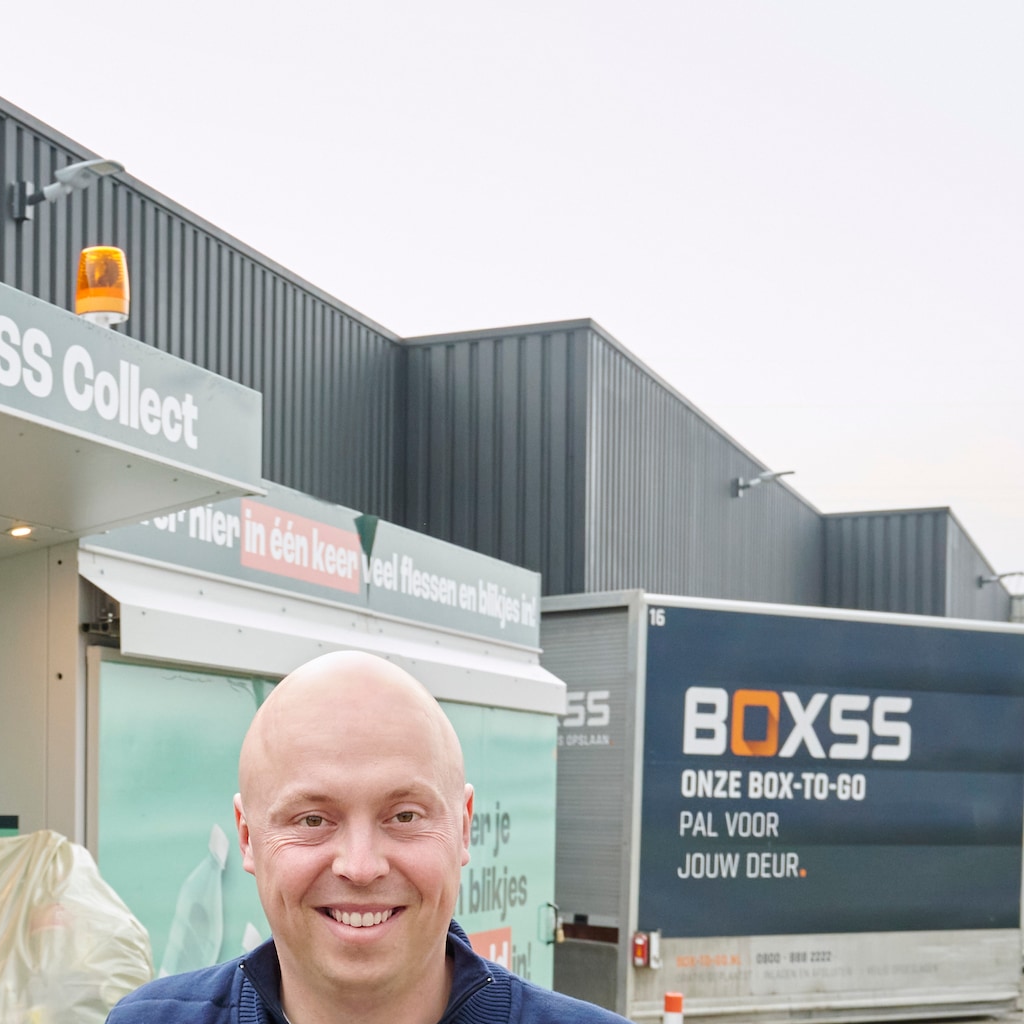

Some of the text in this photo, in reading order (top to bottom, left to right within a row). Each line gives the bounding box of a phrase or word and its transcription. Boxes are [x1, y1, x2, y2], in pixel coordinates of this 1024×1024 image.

[62, 344, 198, 450] Collect
[245, 508, 266, 557] in
[270, 515, 309, 568] één
[312, 527, 358, 579] keer
[361, 553, 398, 592] veel
[401, 554, 457, 607] flessen
[459, 582, 477, 613] en
[478, 578, 521, 629] blikjes
[649, 608, 666, 627] 16
[683, 686, 912, 761] BOXSS
[681, 769, 866, 801] ONZE BOX-TO-GO
[493, 801, 511, 858] je
[679, 811, 779, 838] PAL VOOR
[677, 852, 807, 880] JOUW DEUR.
[469, 866, 527, 922] blikjes
[810, 951, 832, 963] 2222
